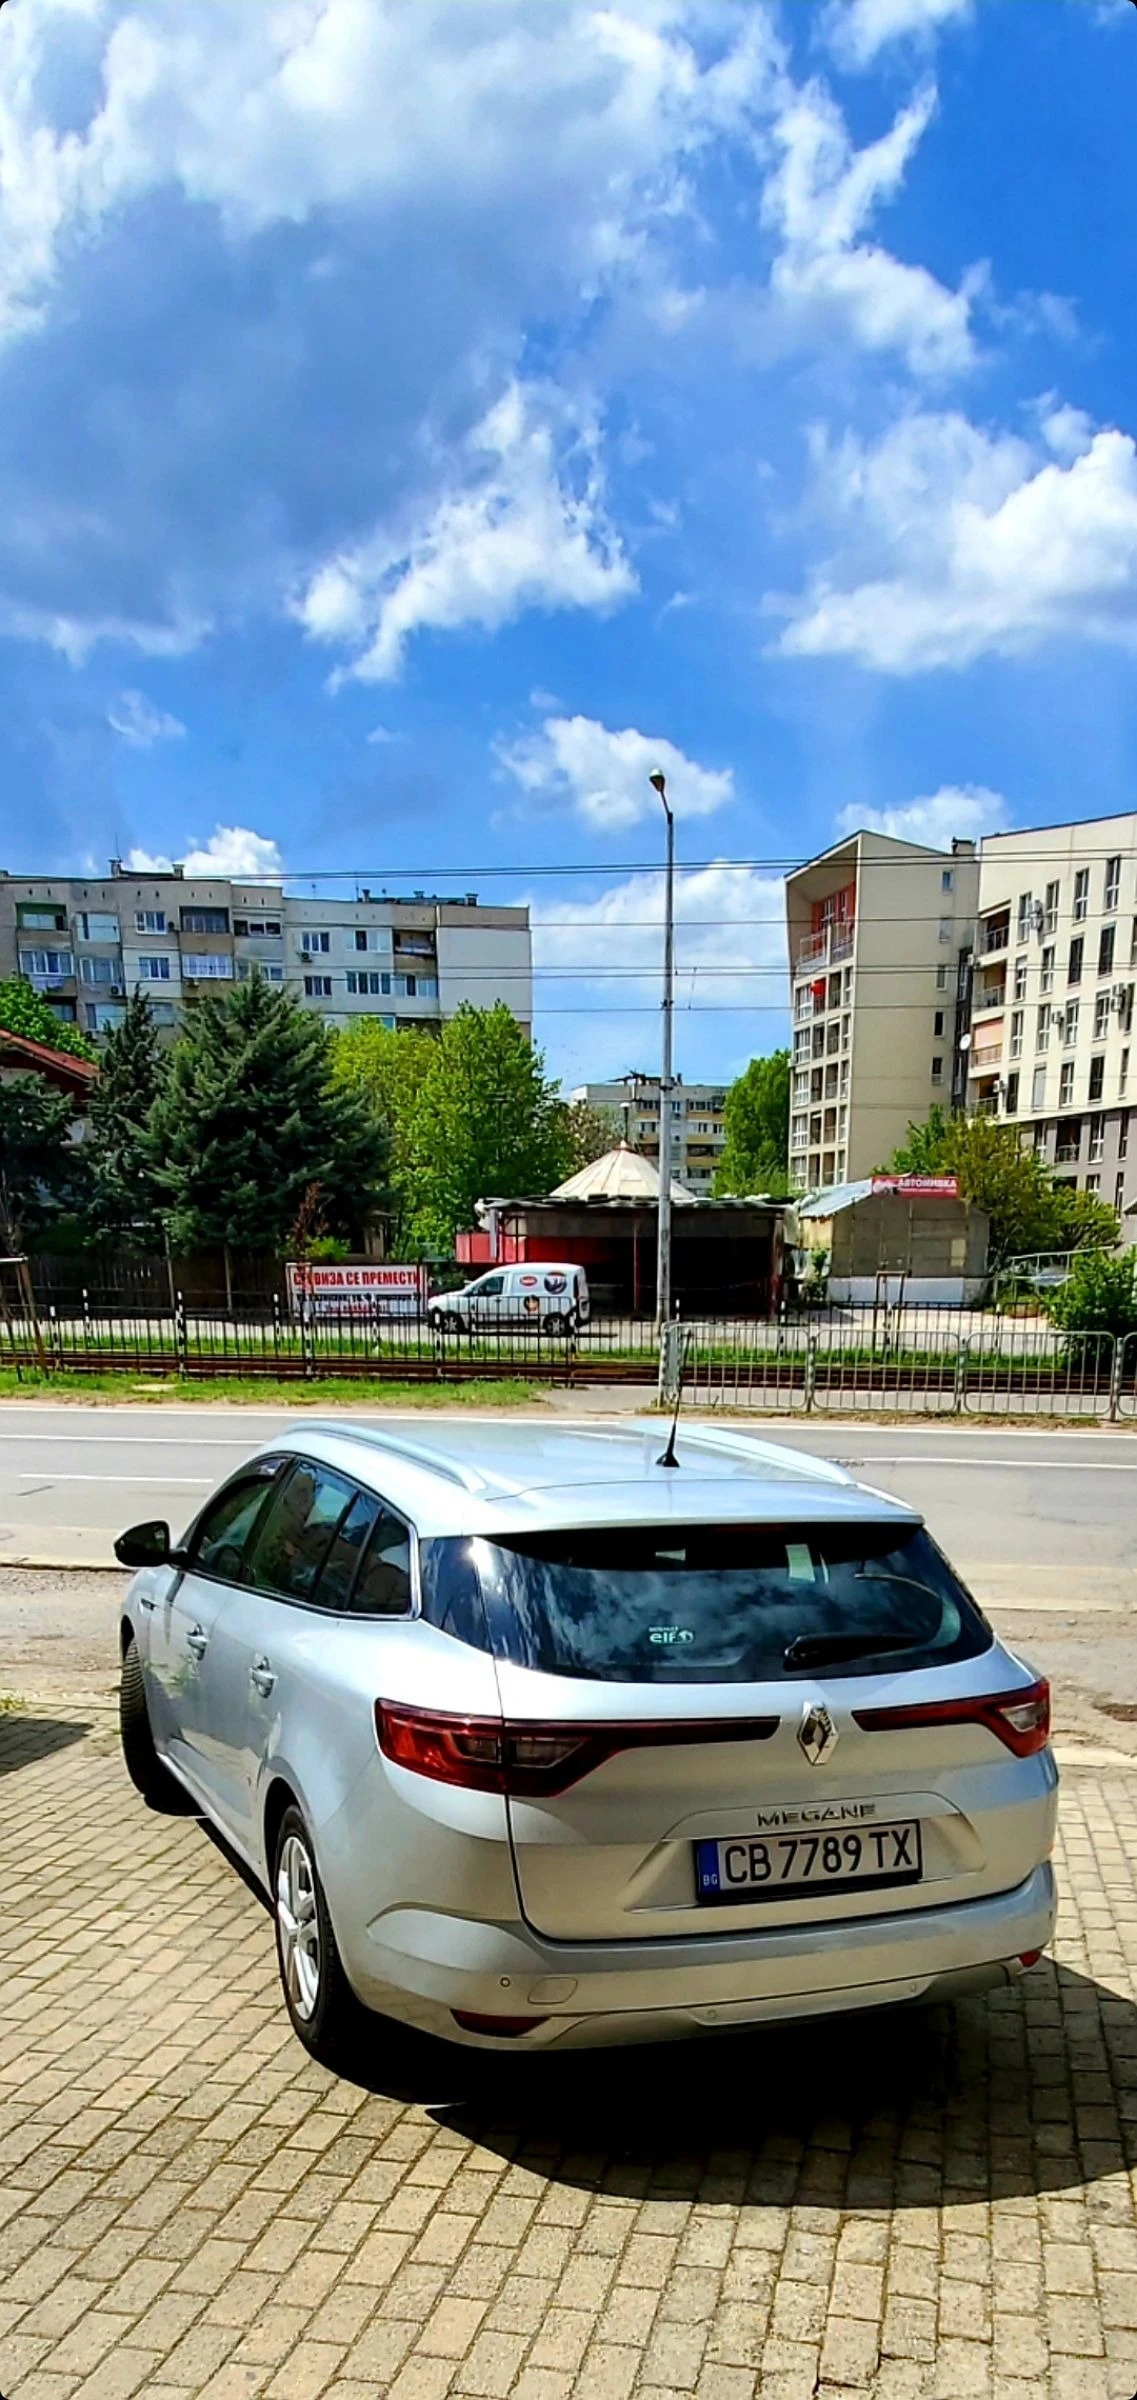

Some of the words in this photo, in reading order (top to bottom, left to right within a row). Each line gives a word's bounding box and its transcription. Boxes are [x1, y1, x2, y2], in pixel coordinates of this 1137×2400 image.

[294, 1272, 344, 1286] СВИЗА
[346, 1272, 360, 1286] СЕ
[650, 1632, 676, 1644] elf
[757, 1803, 876, 1827] MEGANE
[725, 1843, 772, 1883] CB
[778, 1834, 862, 1879] 7789
[868, 1828, 912, 1868] TX
[703, 1873, 718, 1886] BG
